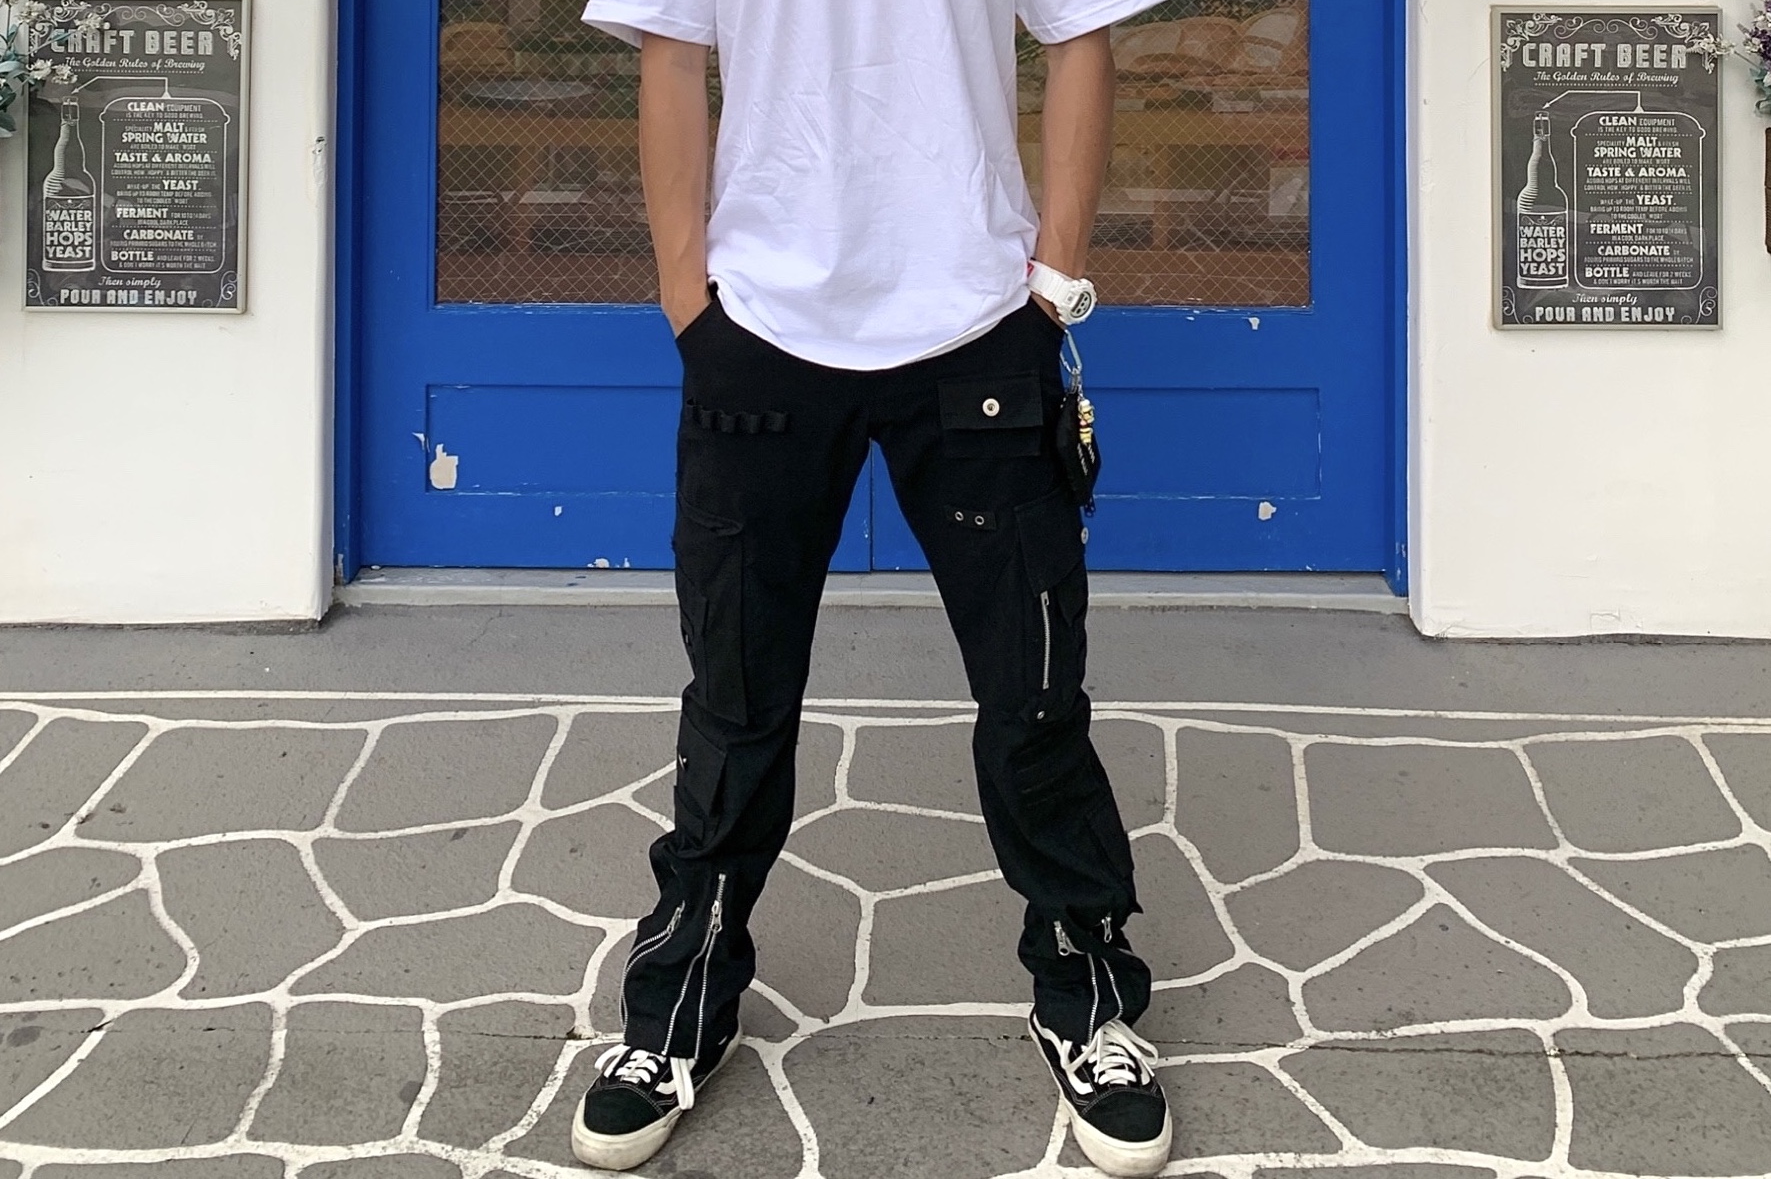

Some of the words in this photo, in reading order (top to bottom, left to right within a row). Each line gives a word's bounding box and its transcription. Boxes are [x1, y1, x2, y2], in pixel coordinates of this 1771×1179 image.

[50, 28, 135, 54] CRAFT
[145, 30, 213, 55] BEER
[1522, 42, 1607, 68] CRAFT
[1616, 43, 1687, 69] BEER
[65, 56, 81, 67] The
[82, 56, 116, 68] Golden
[118, 57, 148, 68] Rules
[151, 58, 163, 70] of
[164, 58, 206, 71] Brewing
[1533, 71, 1551, 81] The
[1552, 70, 1588, 82] Golden
[1590, 71, 1620, 82] Rules
[1623, 72, 1635, 84] of
[1636, 72, 1679, 85] Brewing
[127, 101, 165, 112] CLEAN
[1598, 116, 1637, 126] CLEAN
[1639, 118, 1675, 126] EQUIPMENT
[153, 122, 185, 133] MALT
[121, 132, 163, 143] SPRING
[166, 133, 207, 144] WATER
[1625, 136, 1658, 147] MALT
[114, 152, 149, 162] TASTE
[151, 153, 162, 162] &
[1593, 147, 1637, 158] SPRING
[1639, 147, 1682, 158] WATER
[1586, 167, 1622, 177] TASTE
[1624, 167, 1635, 177] &
[45, 209, 92, 221] WATER
[116, 208, 169, 219] FERMENT
[46, 221, 93, 232] BARLEY
[1519, 226, 1565, 238] WATER
[1590, 223, 1644, 235] FERMENT
[46, 231, 93, 246] HOPS
[123, 229, 194, 240] CARBONATE
[1520, 238, 1566, 248] BARLEY
[46, 246, 92, 258] YEAST
[110, 250, 154, 261] BOTTLE
[1520, 248, 1566, 262] HOPS
[1597, 245, 1670, 256] CARBONATE
[1519, 262, 1565, 275] YEAST
[1585, 267, 1630, 278] BOTTLE
[98, 276, 124, 287] Then
[125, 276, 162, 288] simply
[60, 289, 101, 304] POUR
[106, 289, 139, 304] AND
[144, 289, 197, 305] ENJOY
[1572, 293, 1598, 303] Then
[1600, 293, 1638, 305] simply
[1535, 306, 1576, 322] POUR
[1581, 306, 1615, 322] AND
[1620, 306, 1675, 322] ENJOY
